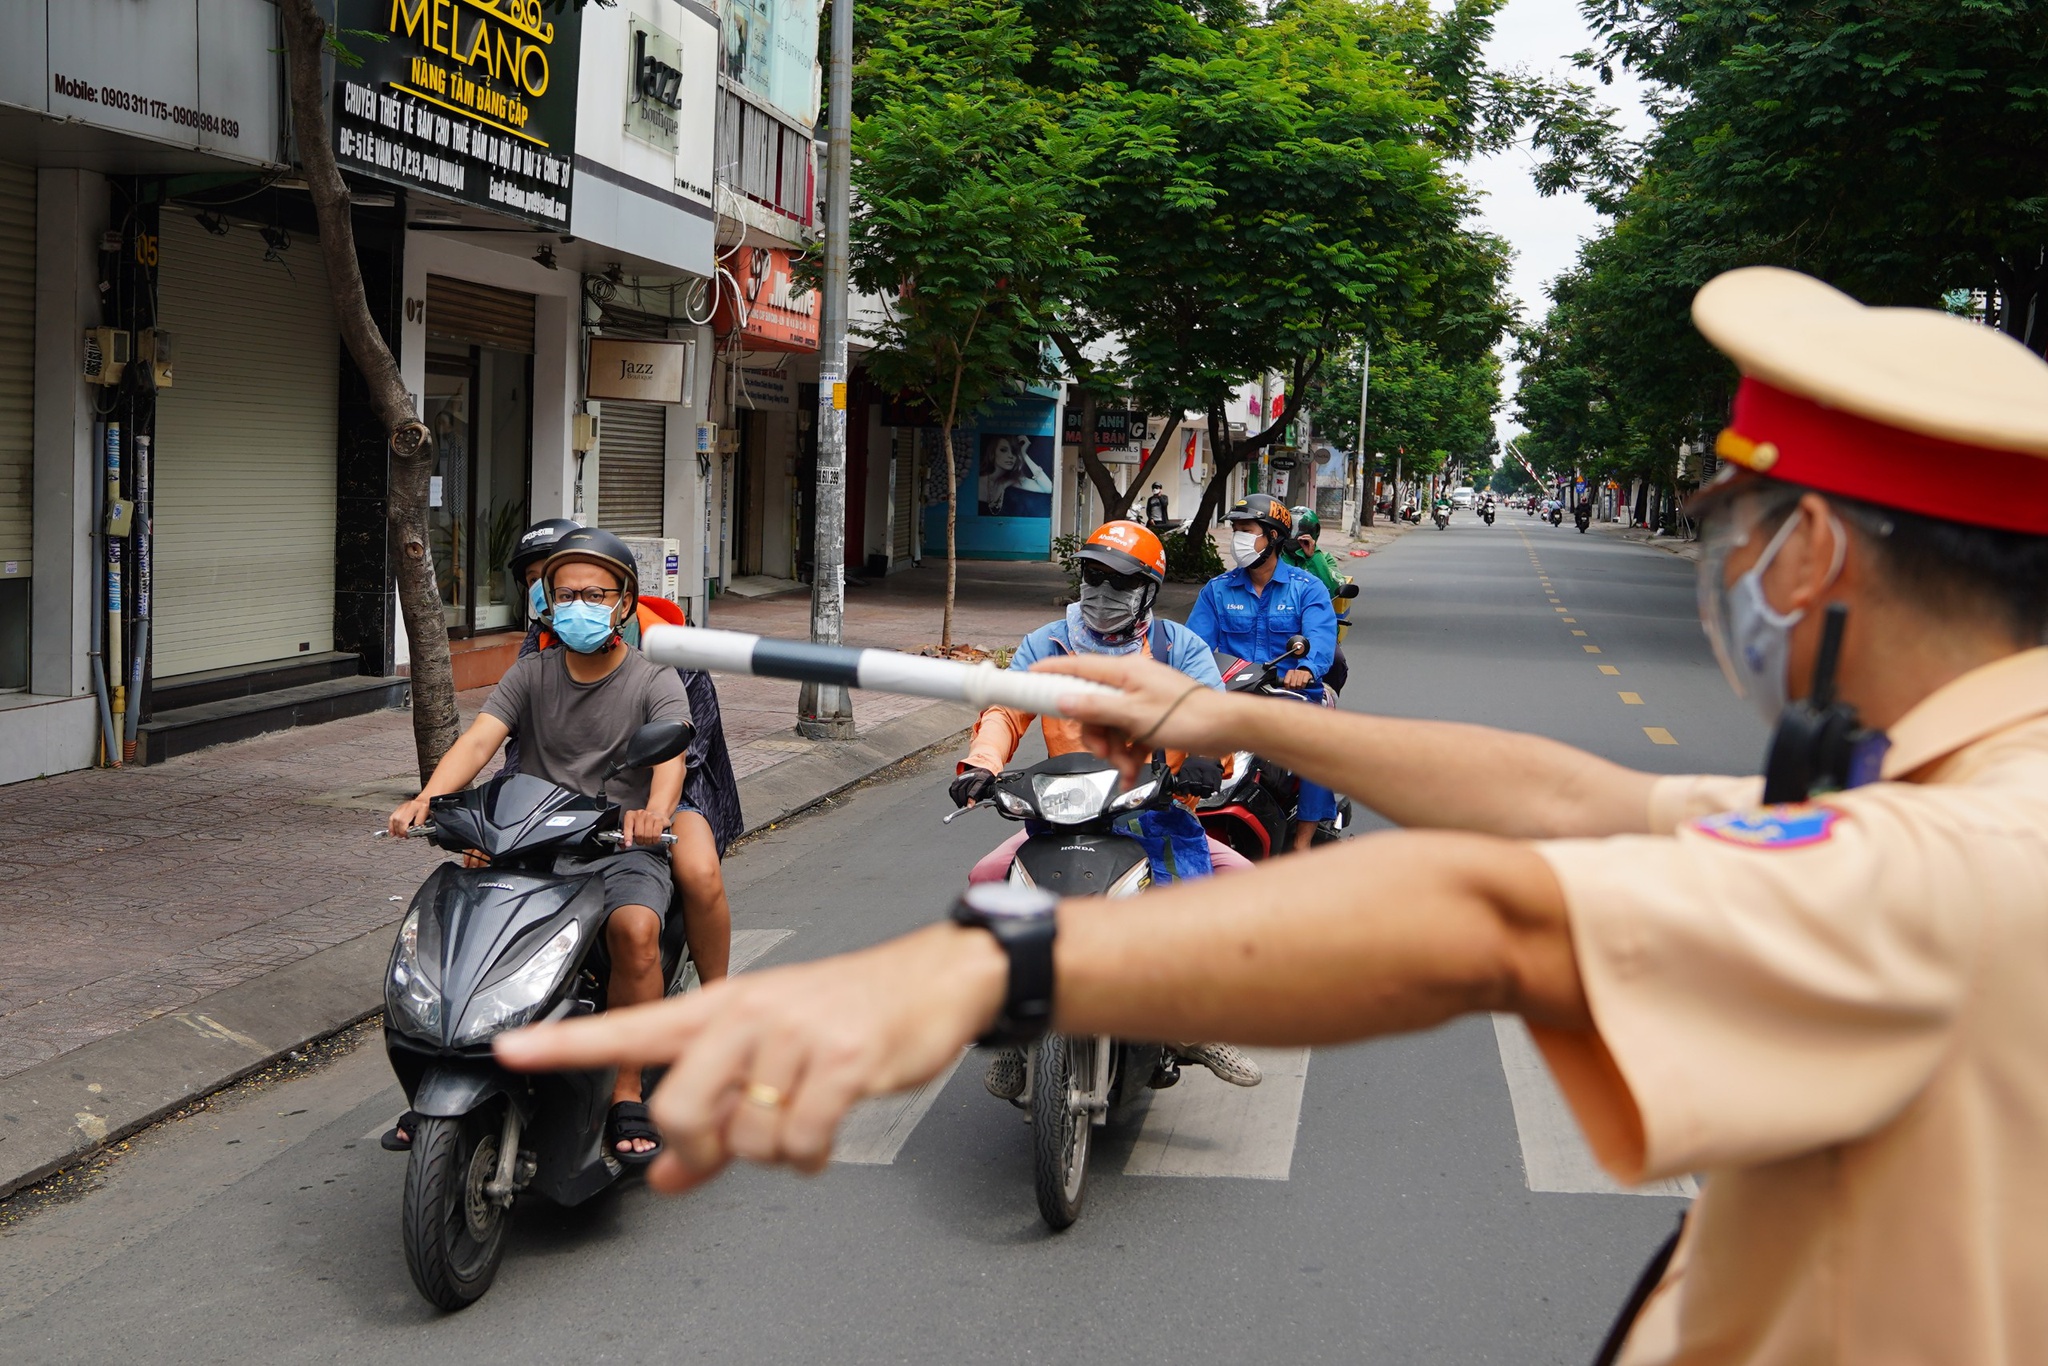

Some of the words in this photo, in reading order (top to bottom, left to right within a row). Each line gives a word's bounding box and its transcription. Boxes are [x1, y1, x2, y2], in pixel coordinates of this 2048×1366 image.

[389, 0, 549, 97] MELANO
[632, 30, 683, 110] Jazz
[55, 73, 98, 103] Mobile:
[101, 86, 130, 111] 0903
[131, 94, 148, 115] 311
[200, 112, 219, 133] 984
[221, 118, 239, 139] 839
[411, 56, 447, 95] NÂNG
[450, 65, 474, 107] TẦM
[508, 93, 529, 128] CẤP
[641, 98, 678, 137] Boutique
[345, 81, 377, 121] CHUYÊN
[380, 91, 401, 131] THIẾT
[403, 96, 416, 135] KẾ
[416, 104, 433, 141] BÁN
[435, 115, 450, 147] CHO
[452, 121, 469, 154] THUÊ
[488, 136, 498, 171] DẠ
[499, 137, 511, 174] HỘI
[511, 140, 522, 173] ÁO
[523, 145, 535, 177] DÀI
[535, 154, 541, 179] &
[543, 152, 560, 185] CÔNG
[362, 131, 374, 163] LÊ
[375, 135, 392, 169] VĂN
[438, 159, 465, 192] NHUẬN
[137, 234, 159, 267] 05
[405, 297, 425, 325] 07
[619, 360, 654, 380] Jazz
[627, 373, 653, 381] Boutique
[1098, 414, 1125, 428] ANH
[1065, 430, 1083, 443] MA
[1102, 429, 1126, 444] BÁN
[1097, 533, 1128, 548] AhaMove
[1060, 845, 1096, 853] HONDA
[477, 882, 515, 890] HONDA
